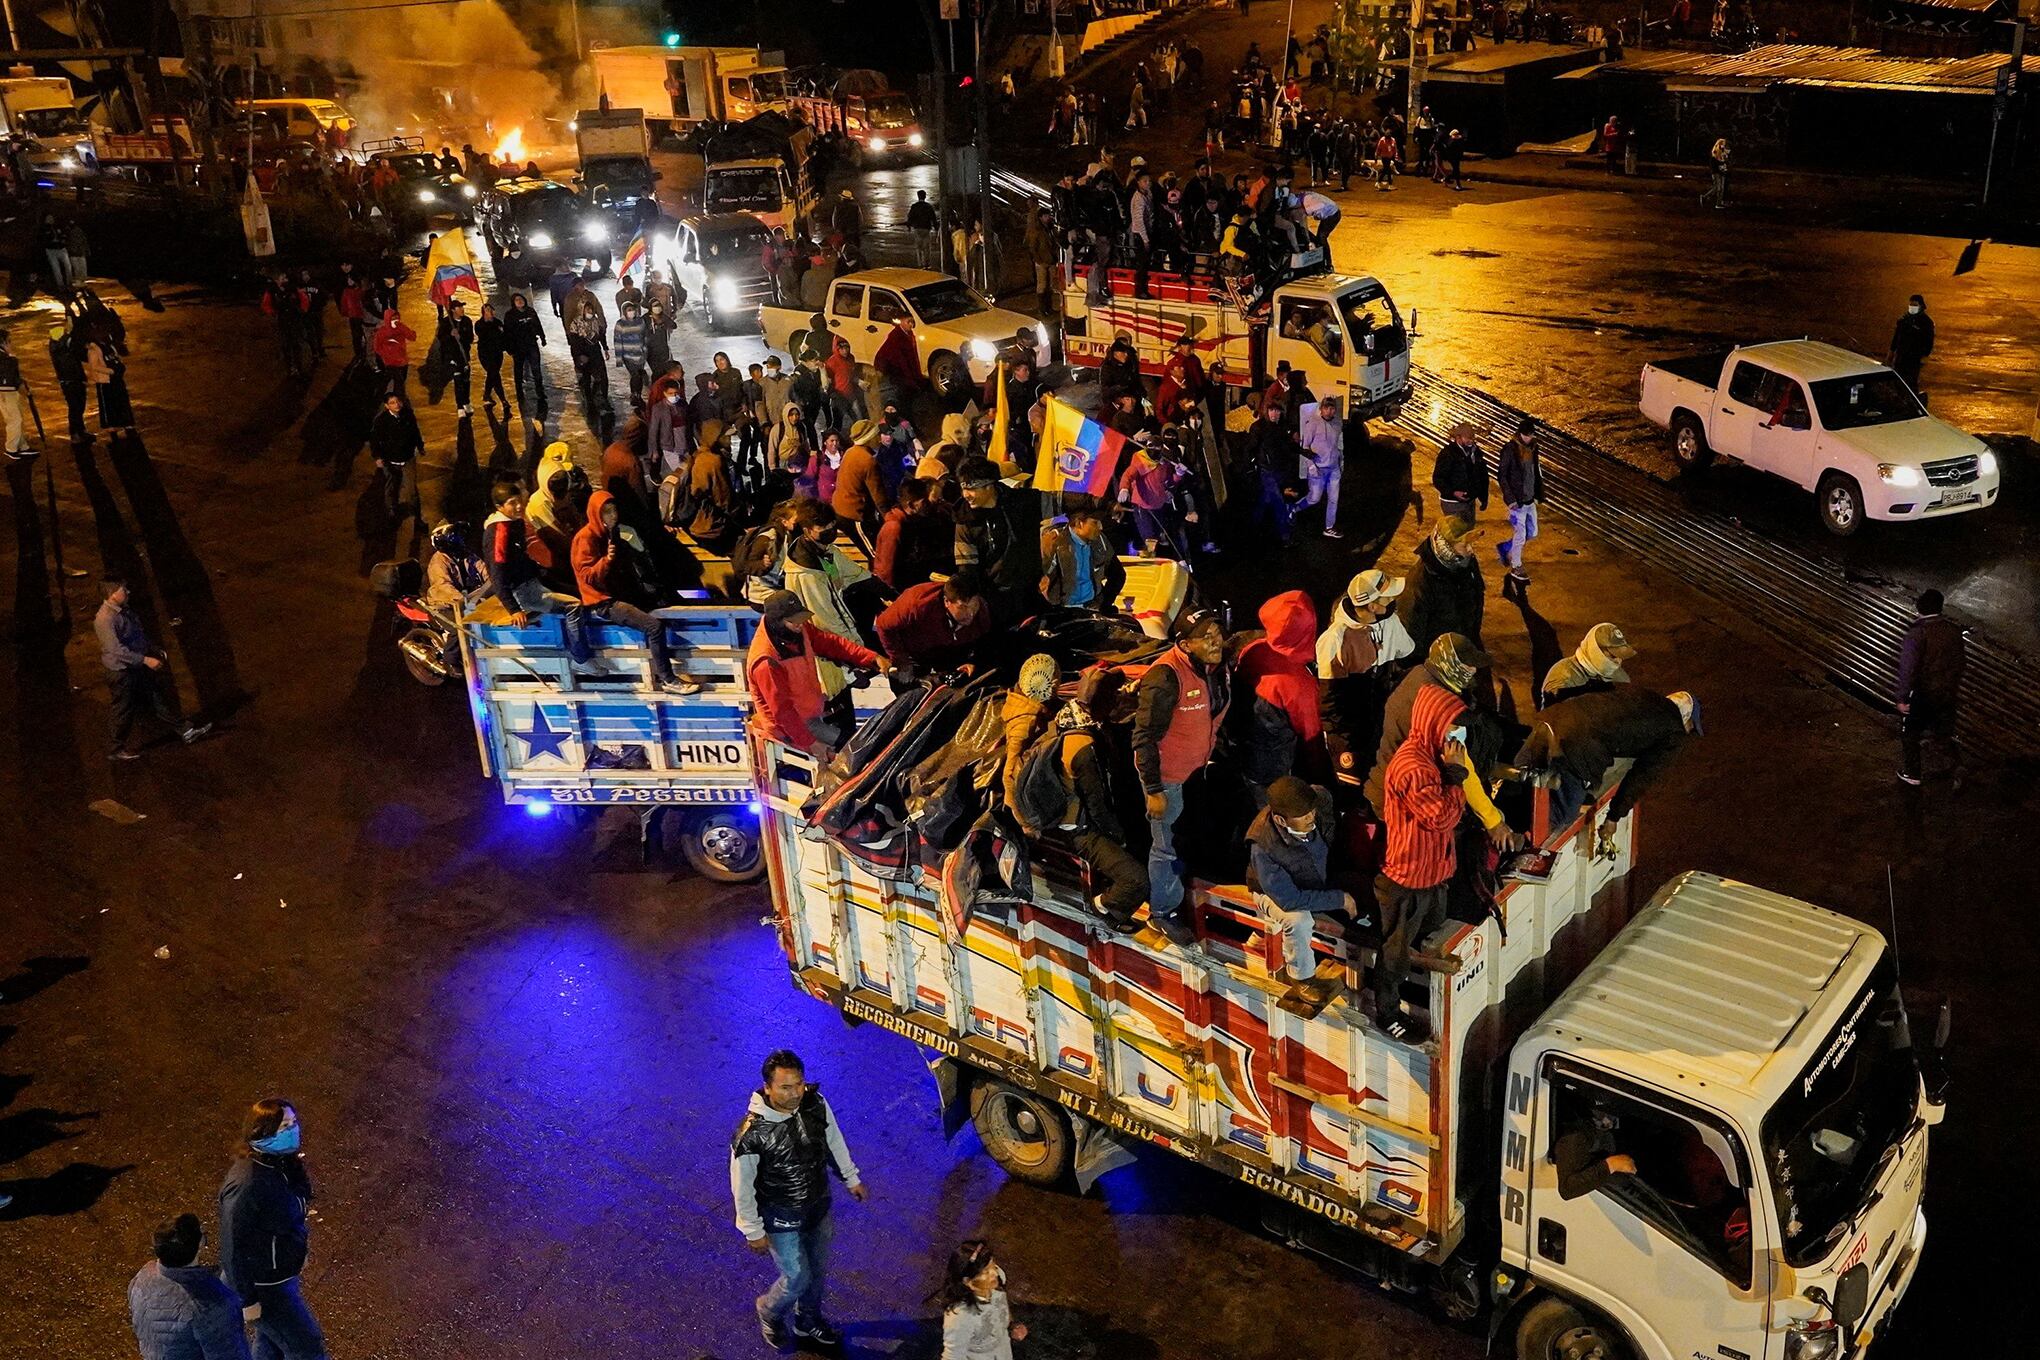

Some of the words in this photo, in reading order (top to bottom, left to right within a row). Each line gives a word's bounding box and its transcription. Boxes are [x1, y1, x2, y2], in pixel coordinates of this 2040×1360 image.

[676, 744, 741, 764] HINO
[843, 996, 960, 1059] RECORRIENDO
[1239, 1164, 1360, 1229] ECUADOR
